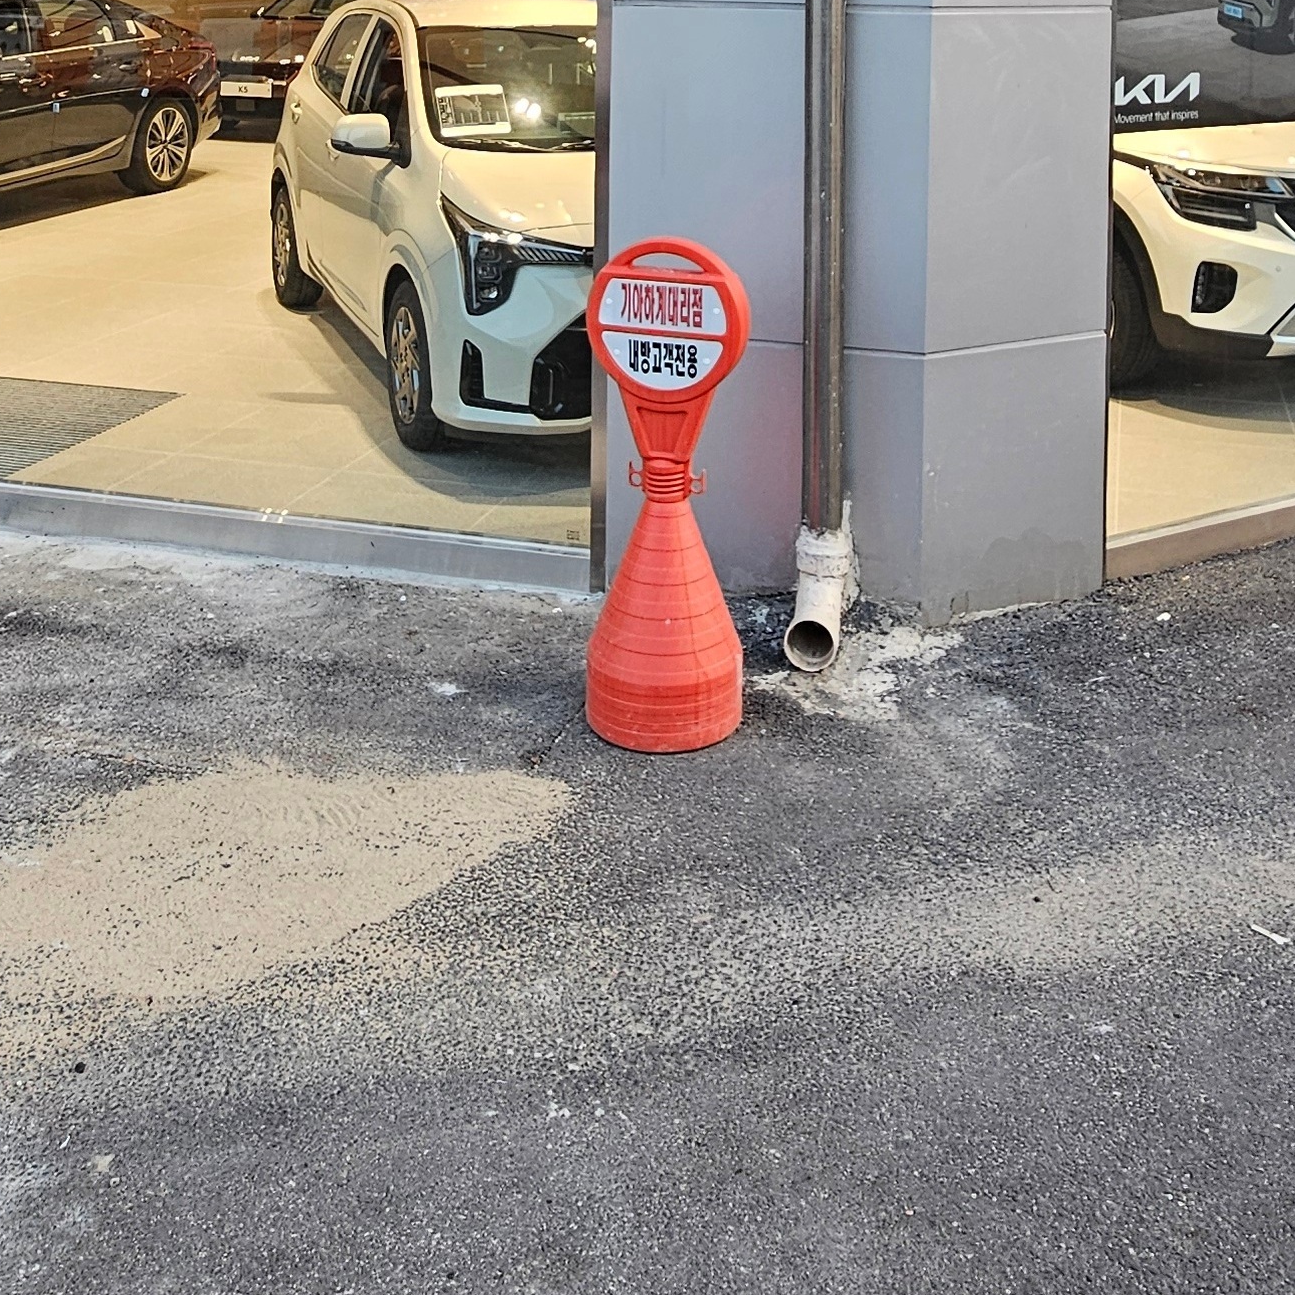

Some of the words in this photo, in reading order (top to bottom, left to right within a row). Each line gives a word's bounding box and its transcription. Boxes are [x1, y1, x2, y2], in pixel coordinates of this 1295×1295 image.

[1114, 72, 1201, 106] KIA
[1115, 111, 1153, 124] Movement
[1155, 110, 1170, 122] that
[1171, 109, 1199, 121] inspires
[621, 283, 703, 328] 기아하계대리점
[628, 339, 698, 379] 내방고객전용
